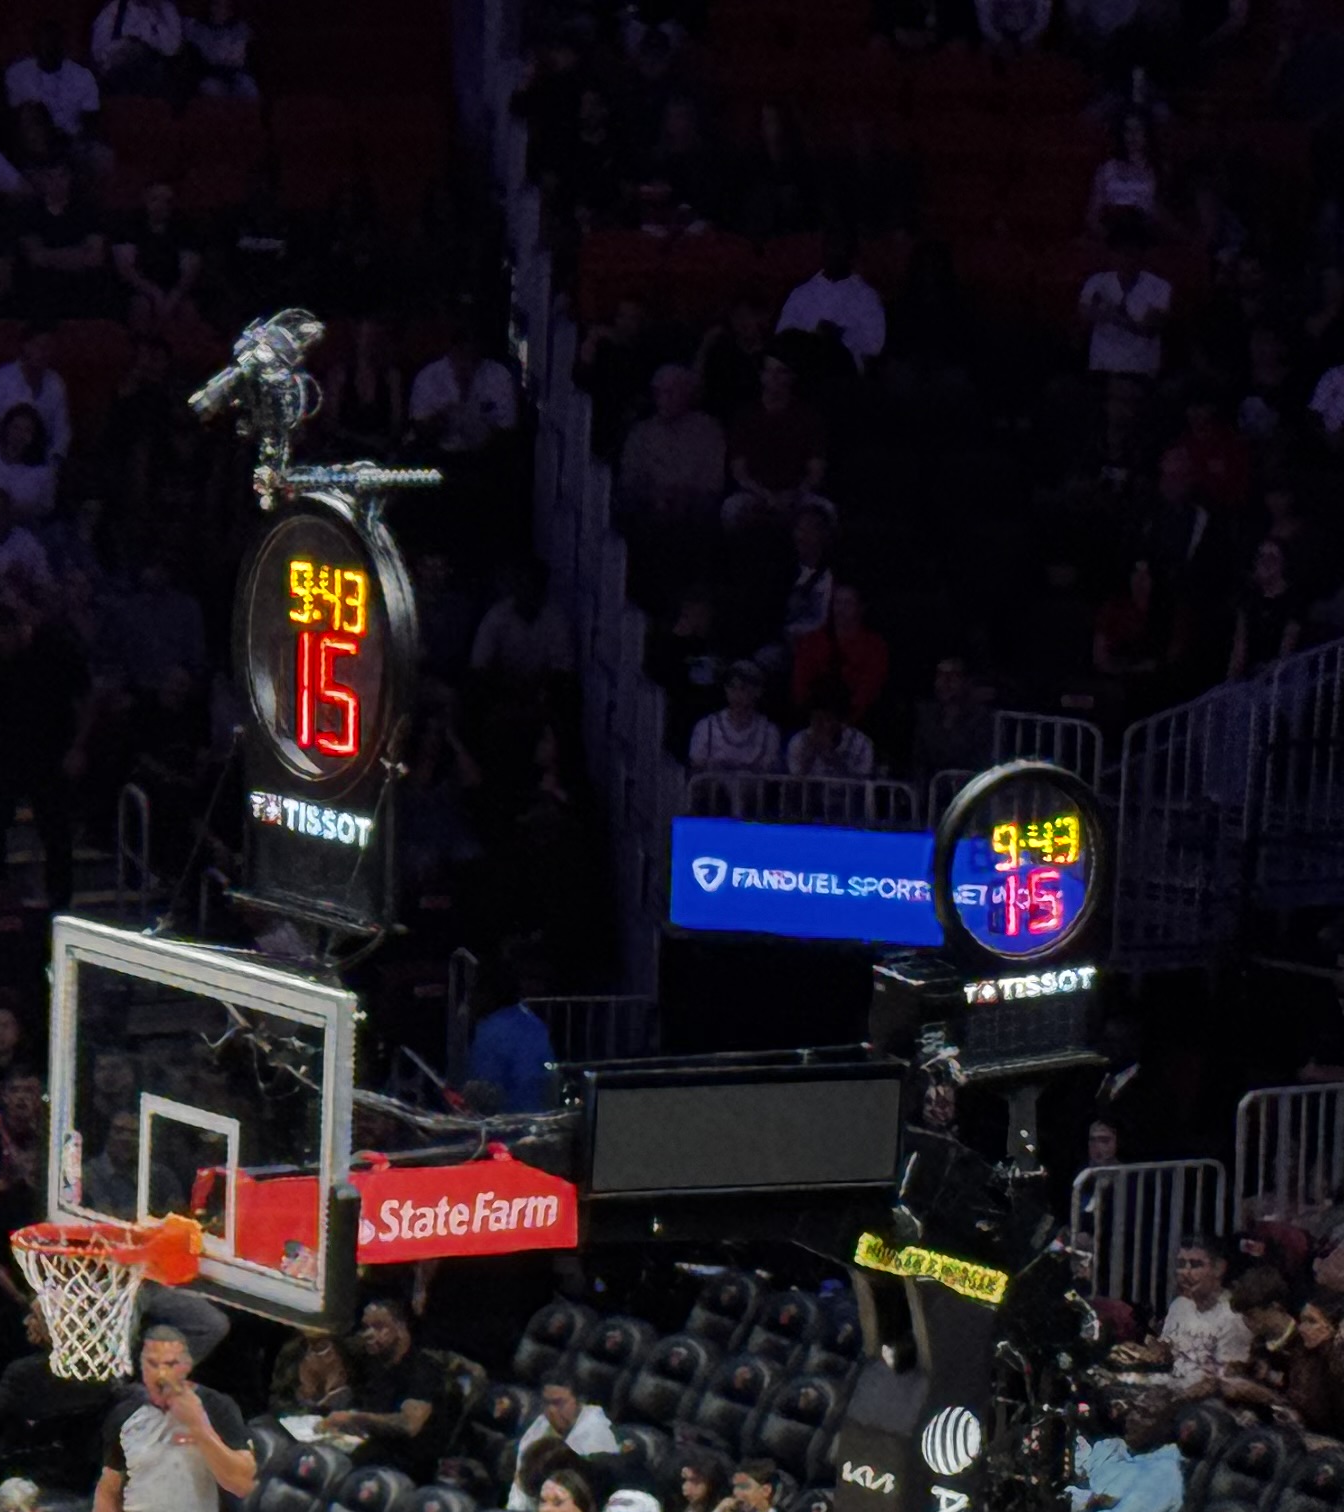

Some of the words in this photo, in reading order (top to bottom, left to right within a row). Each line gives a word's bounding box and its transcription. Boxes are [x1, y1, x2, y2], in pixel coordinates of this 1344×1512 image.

[289, 559, 365, 635] 9:43
[296, 632, 360, 757] 15
[282, 797, 373, 849] TISSOT
[992, 816, 1080, 872] 9:43
[731, 867, 845, 895] FANDUEL
[1005, 868, 1064, 936] 15
[997, 966, 1097, 1001] TISSOT
